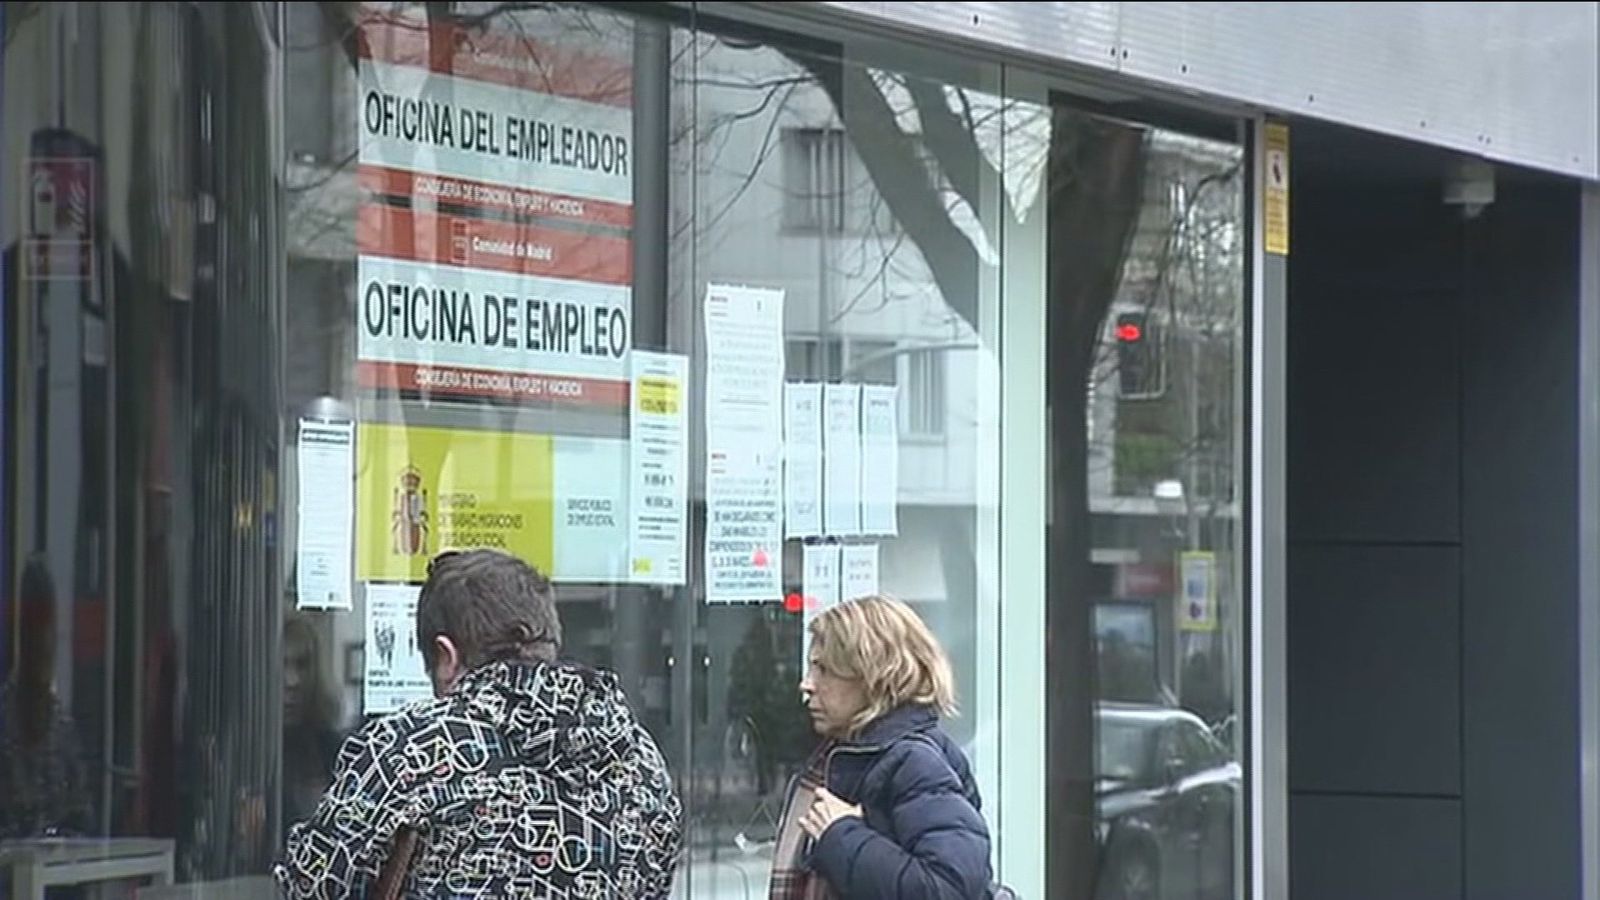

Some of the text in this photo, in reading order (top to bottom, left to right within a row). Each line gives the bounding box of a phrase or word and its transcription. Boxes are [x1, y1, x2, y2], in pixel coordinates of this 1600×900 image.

[364, 90, 628, 176] OFICINA DEL EMPLEADOR
[364, 280, 627, 359] OFICINA DE EMPLEO
